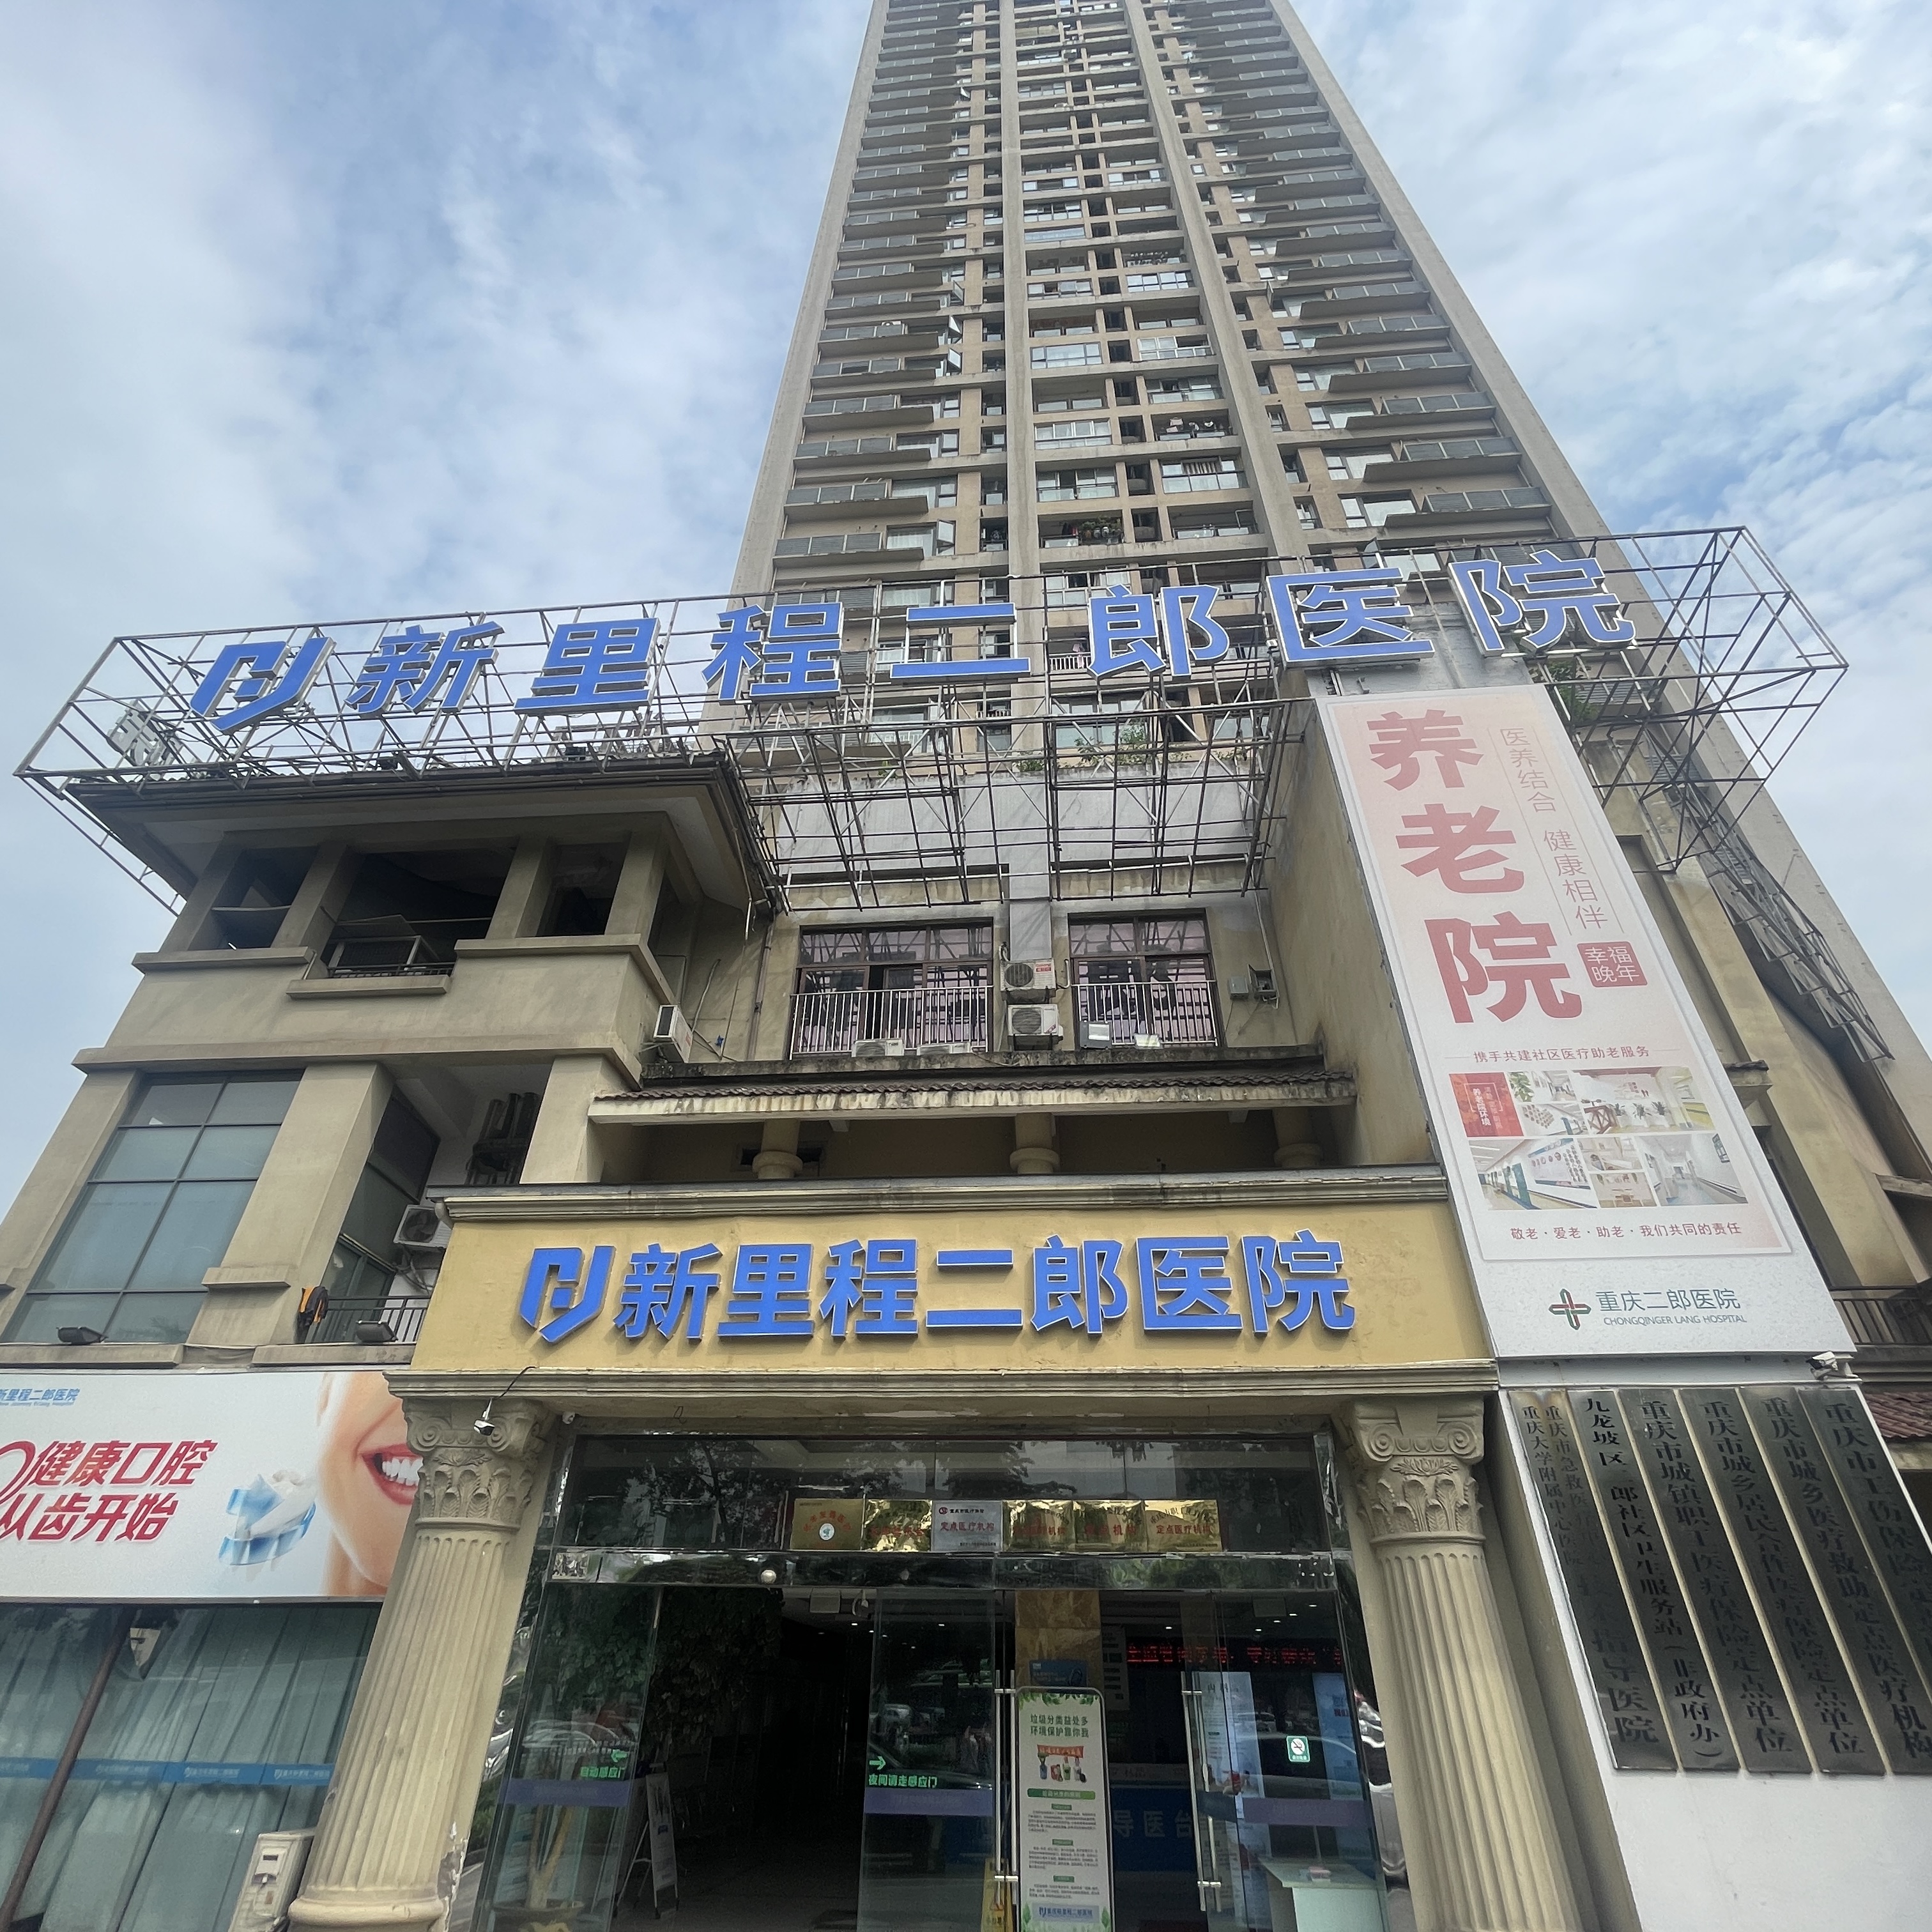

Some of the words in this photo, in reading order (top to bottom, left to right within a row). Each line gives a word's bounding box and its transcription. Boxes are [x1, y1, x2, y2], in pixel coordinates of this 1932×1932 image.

[345, 550, 1636, 717] 新里程二郎医院
[1499, 728, 1557, 813] 医养结合
[1543, 829, 1608, 930] 健康相伴
[1367, 709, 1582, 1023] 养老院
[1584, 946, 1633, 963] 幸福
[1592, 963, 1640, 983] 晚年
[1474, 1046, 1649, 1062] 携手共建社区医疗助老服务
[612, 1229, 1356, 1342] 新里程二郎医院
[1596, 1288, 1741, 1312] 重庆二郎医院
[1604, 1316, 1673, 1326] CHONGQINGER
[1674, 1315, 1701, 1324] LANG
[1703, 1314, 1747, 1324] HOSPITAL
[28, 1440, 218, 1487] 健康口腔
[0, 1492, 179, 1542] 从齿开始
[940, 1521, 995, 1532] 定点医疗机构
[869, 1774, 937, 1788] 夜间请走感应门
